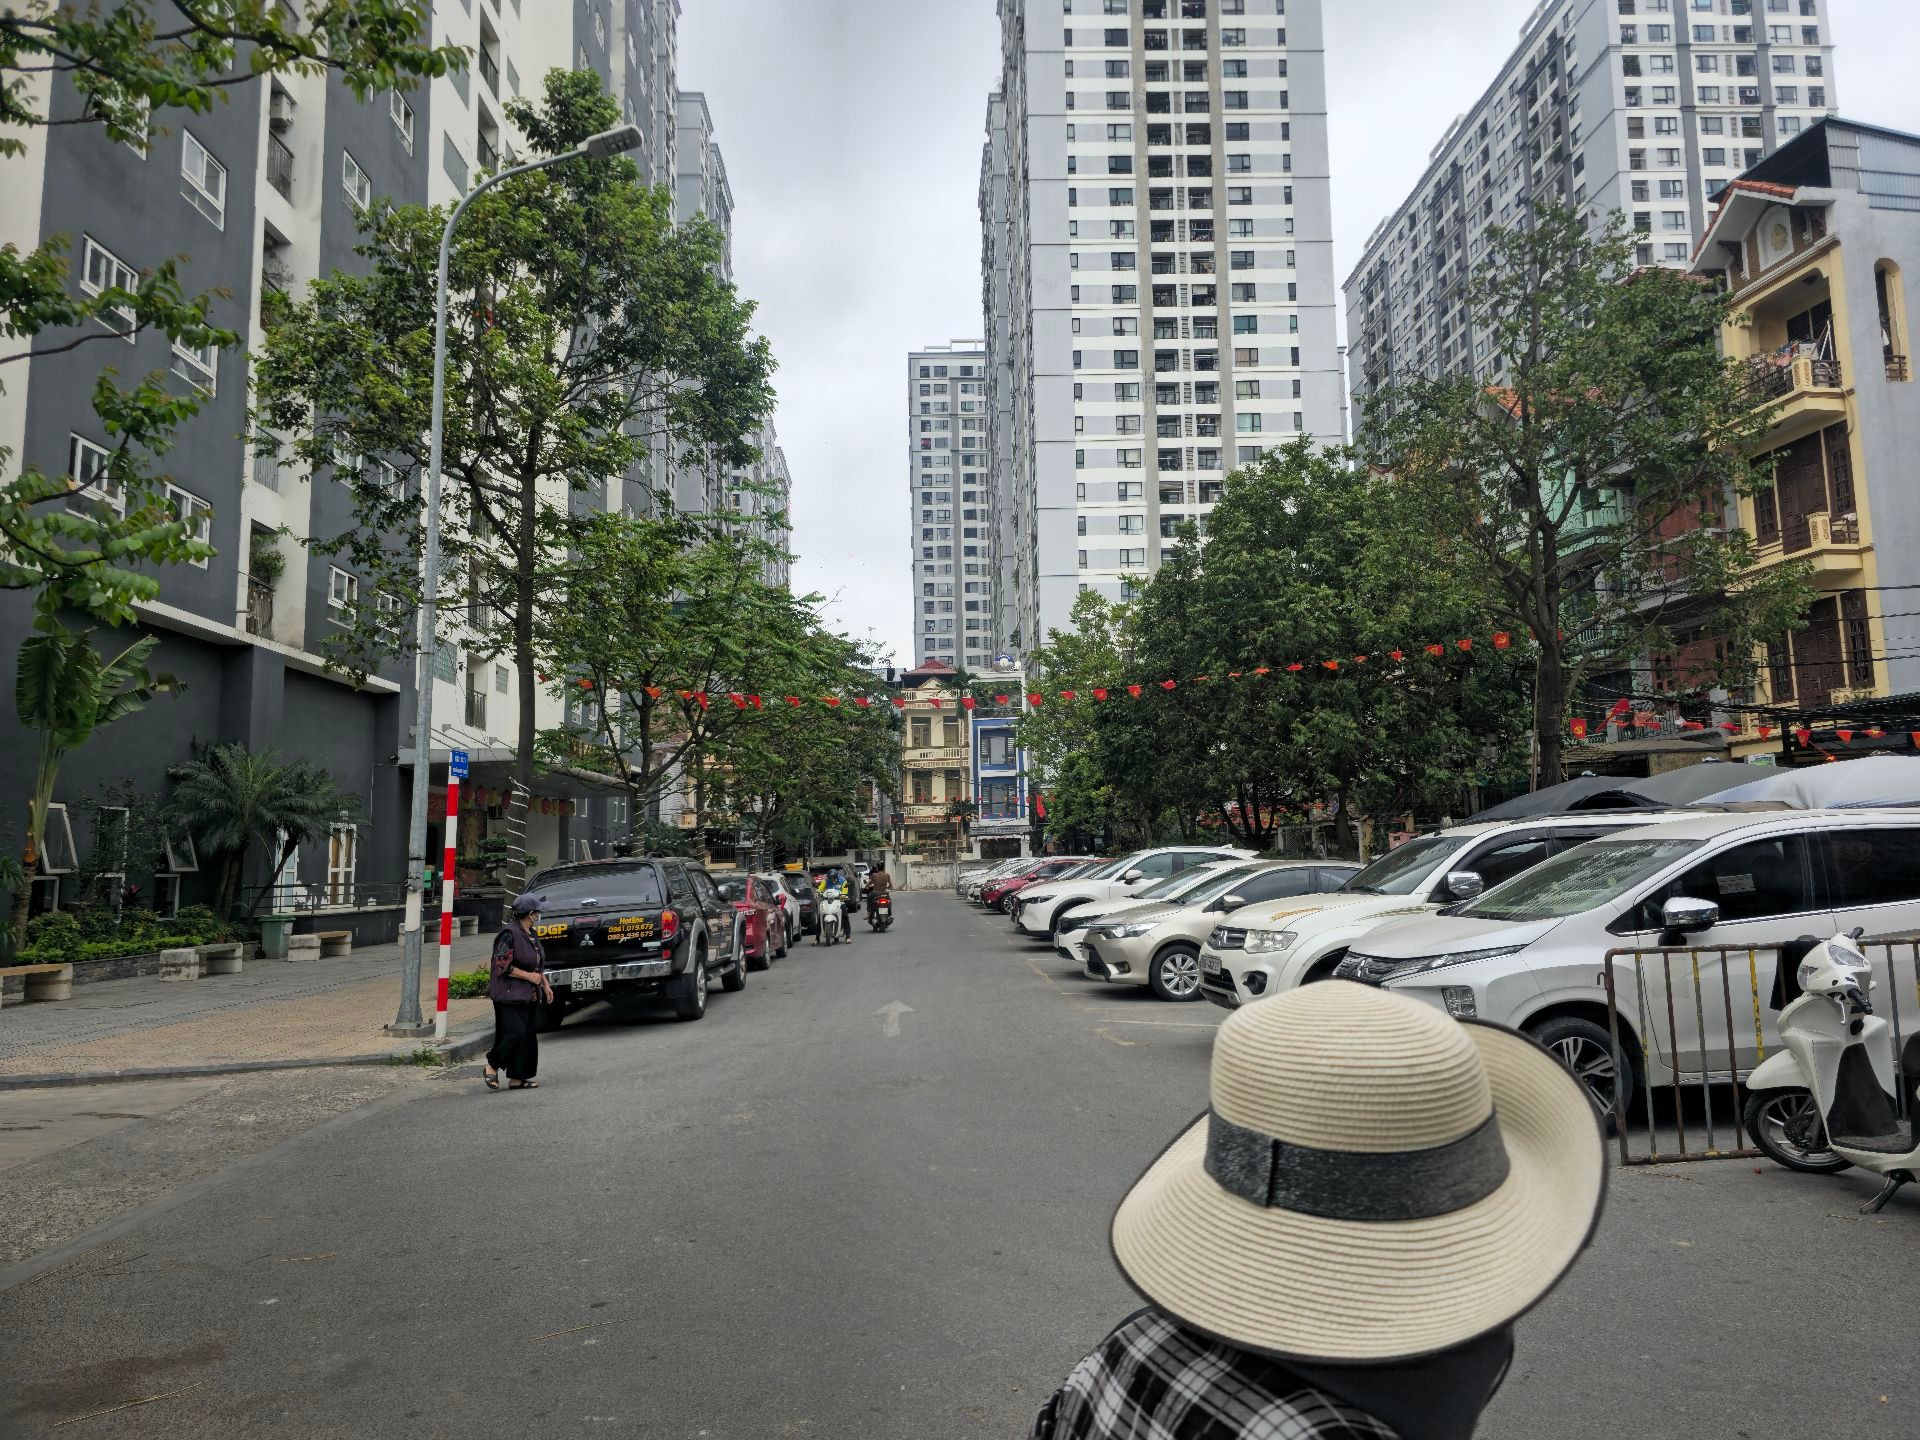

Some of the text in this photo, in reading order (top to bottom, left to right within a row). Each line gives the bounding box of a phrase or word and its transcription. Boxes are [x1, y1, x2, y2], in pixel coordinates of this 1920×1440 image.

[619, 916, 644, 924] Hotline
[578, 969, 595, 980] 29C
[572, 978, 601, 990] 351.32
